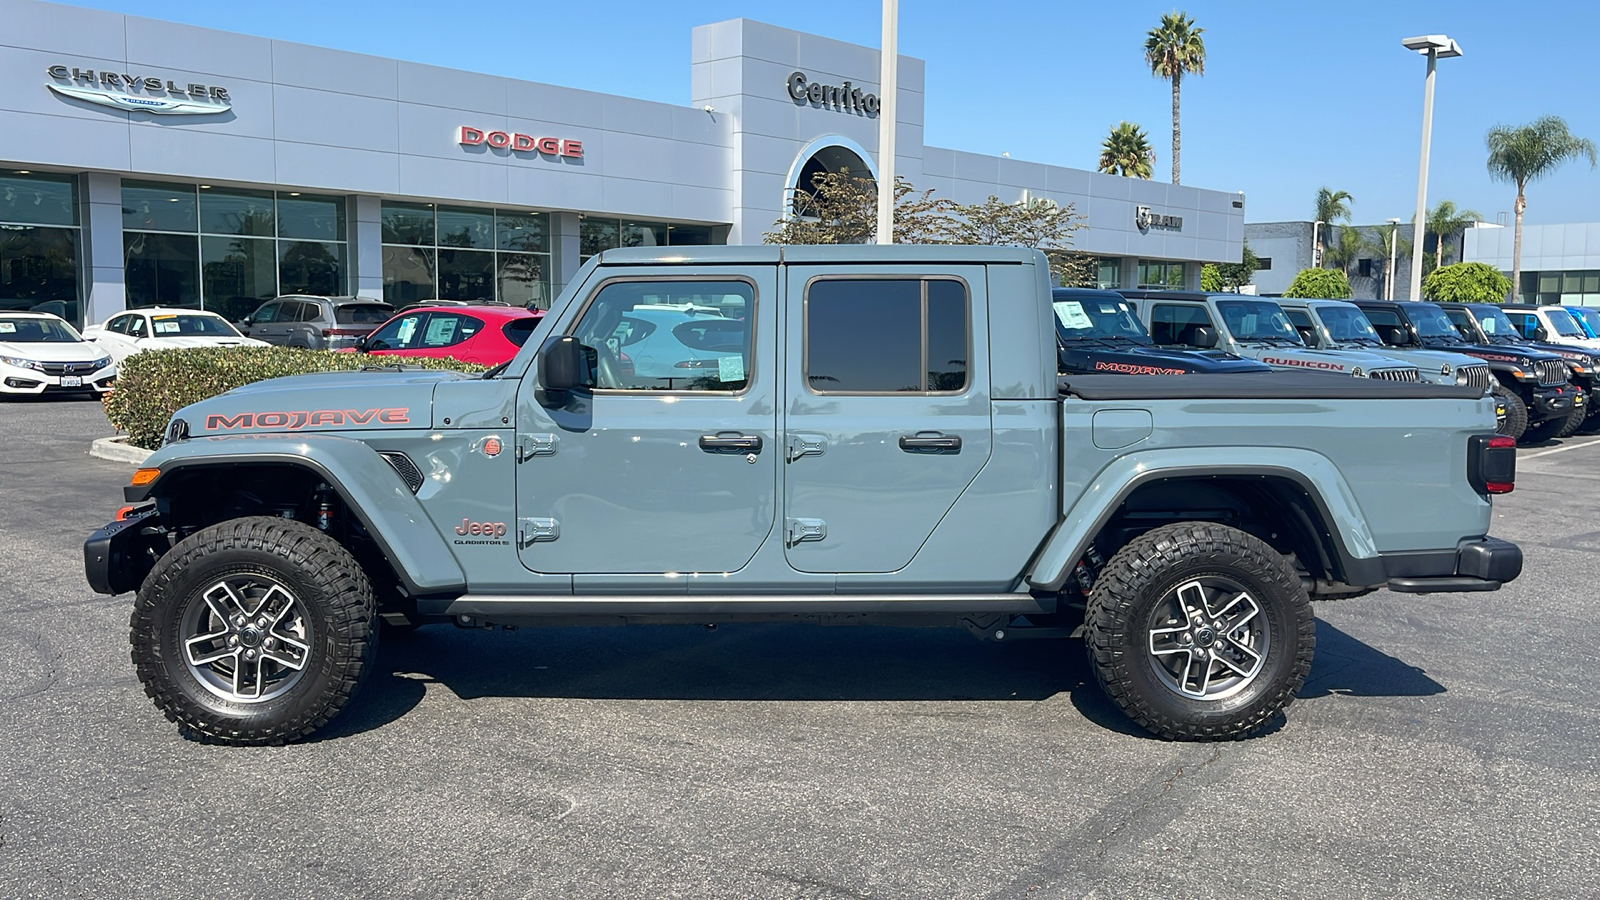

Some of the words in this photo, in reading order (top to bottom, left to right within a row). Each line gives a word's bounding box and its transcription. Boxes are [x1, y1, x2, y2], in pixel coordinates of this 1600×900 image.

[48, 65, 229, 99] CHRYSLER
[787, 71, 881, 114] Cerrito
[458, 126, 583, 157] DODGE
[1150, 213, 1183, 228] RAM
[1263, 357, 1344, 371] RUBICON
[205, 407, 410, 430] MOJAVE
[454, 518, 507, 539] Jeep
